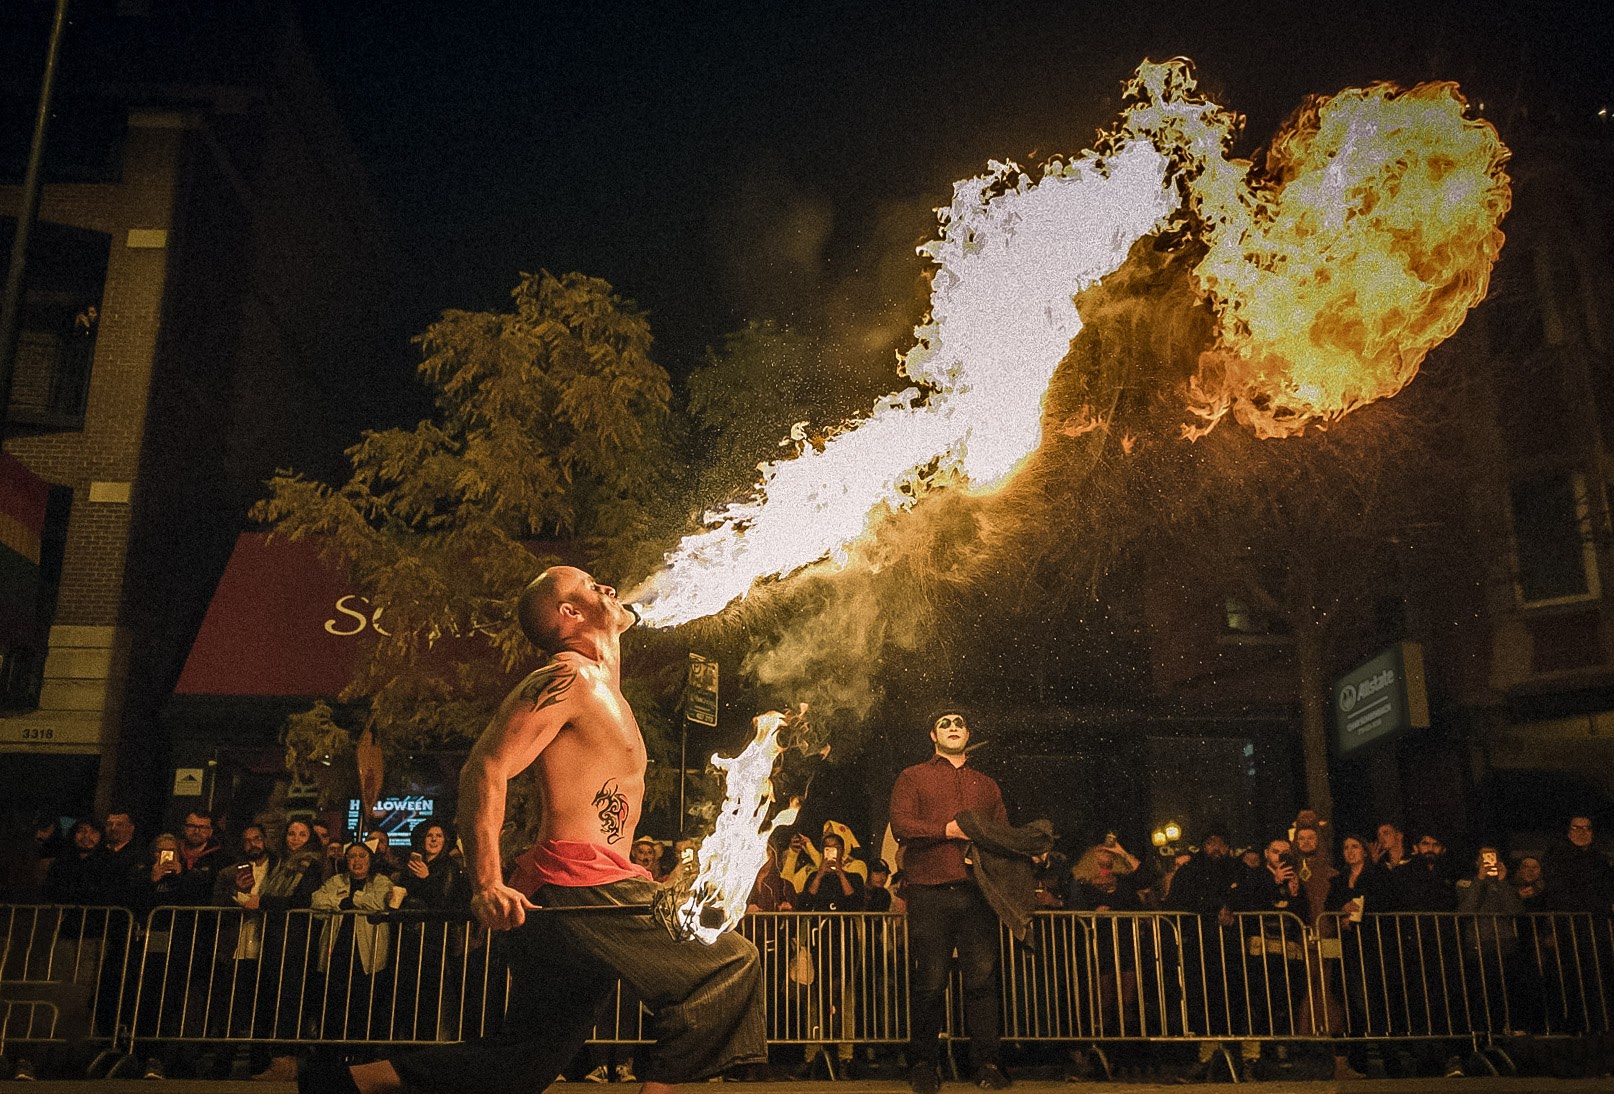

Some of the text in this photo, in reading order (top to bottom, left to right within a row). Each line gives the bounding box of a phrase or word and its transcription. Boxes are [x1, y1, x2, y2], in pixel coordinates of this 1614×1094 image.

[1357, 669, 1394, 701] Allstate
[22, 728, 54, 739] 3318
[350, 799, 434, 812] HLOWEEN
